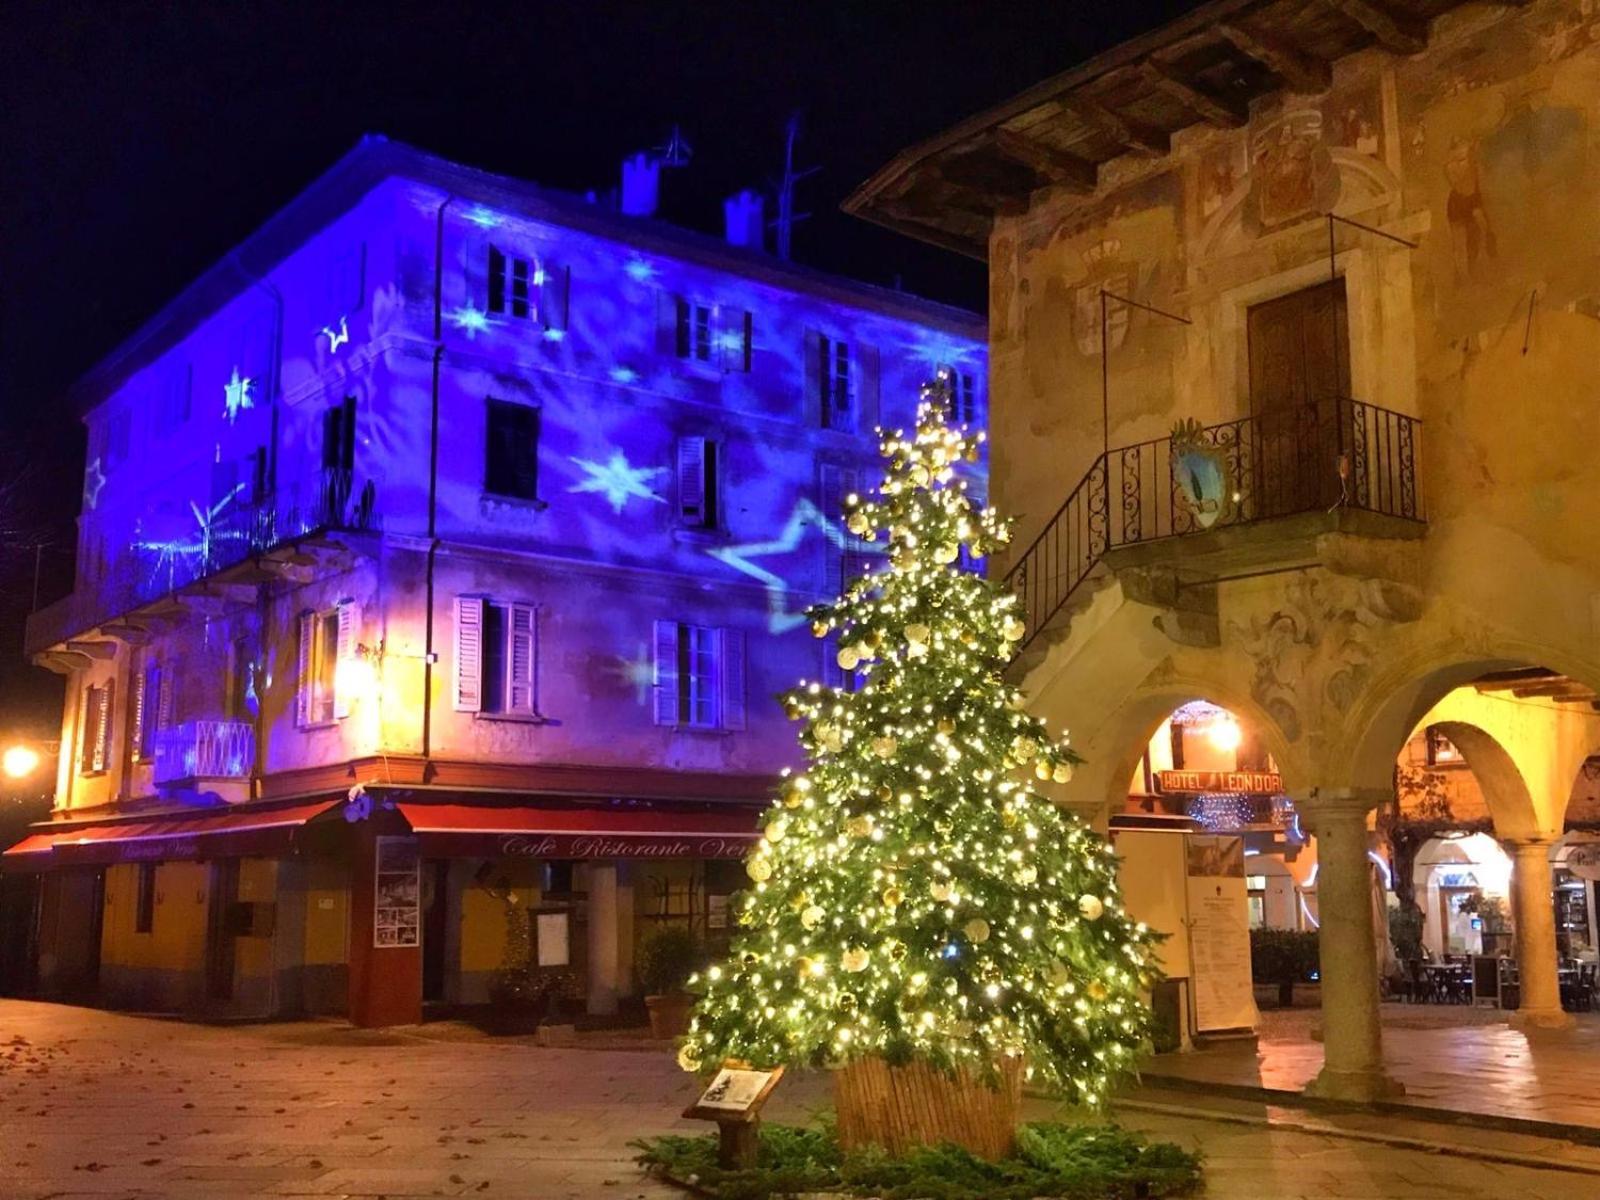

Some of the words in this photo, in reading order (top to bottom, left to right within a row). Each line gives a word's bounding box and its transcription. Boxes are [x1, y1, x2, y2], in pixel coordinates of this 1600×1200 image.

[1163, 772, 1204, 790] HOTEL
[1219, 773, 1253, 791] LEON
[569, 837, 691, 857] Ristorante
